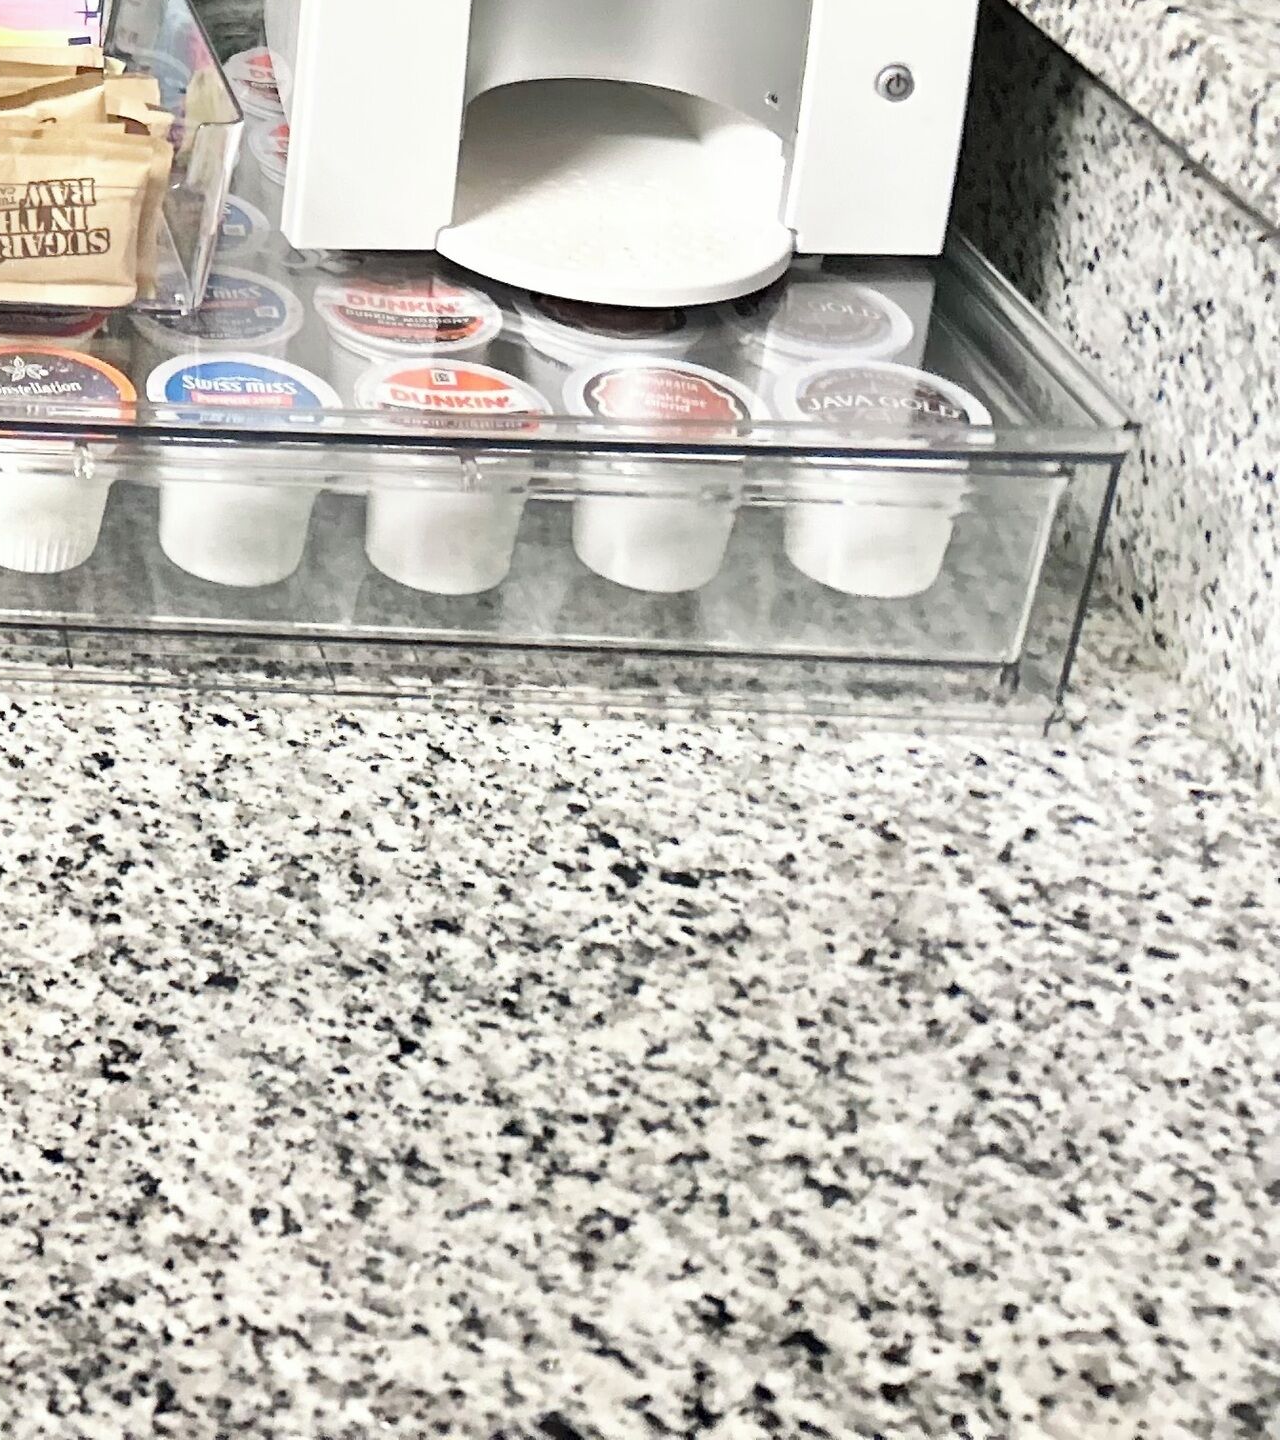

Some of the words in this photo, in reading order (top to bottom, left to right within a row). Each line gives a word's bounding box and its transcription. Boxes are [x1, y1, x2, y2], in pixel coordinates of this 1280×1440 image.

[19, 178, 97, 210] RAW
[48, 206, 90, 234] IN
[345, 292, 462, 315] DUNKIN'
[388, 387, 511, 409] DUNKIN'
[807, 394, 873, 411] JAVA
[878, 396, 963, 420] GOLD
